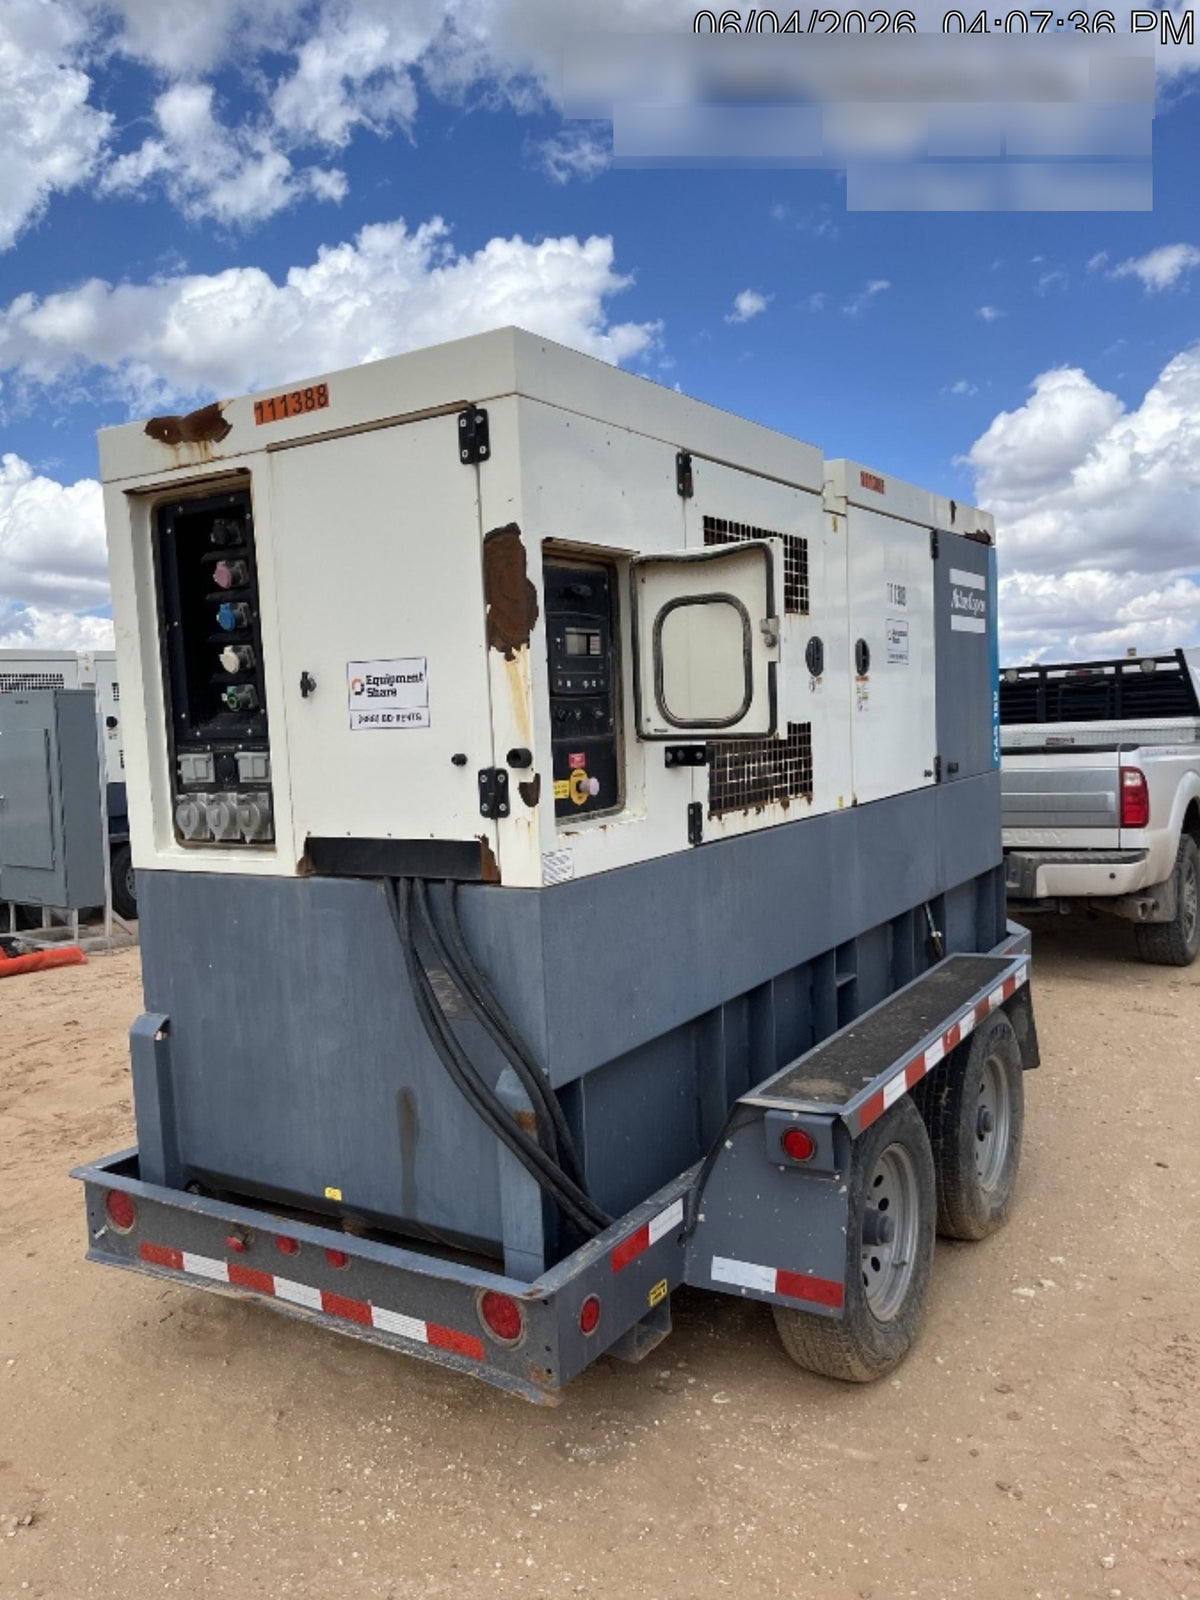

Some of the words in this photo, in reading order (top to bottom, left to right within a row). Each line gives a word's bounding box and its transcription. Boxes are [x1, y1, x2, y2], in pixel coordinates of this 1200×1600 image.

[254, 383, 328, 425] 111388
[366, 672, 424, 687] Equipment
[366, 687, 397, 698] Share
